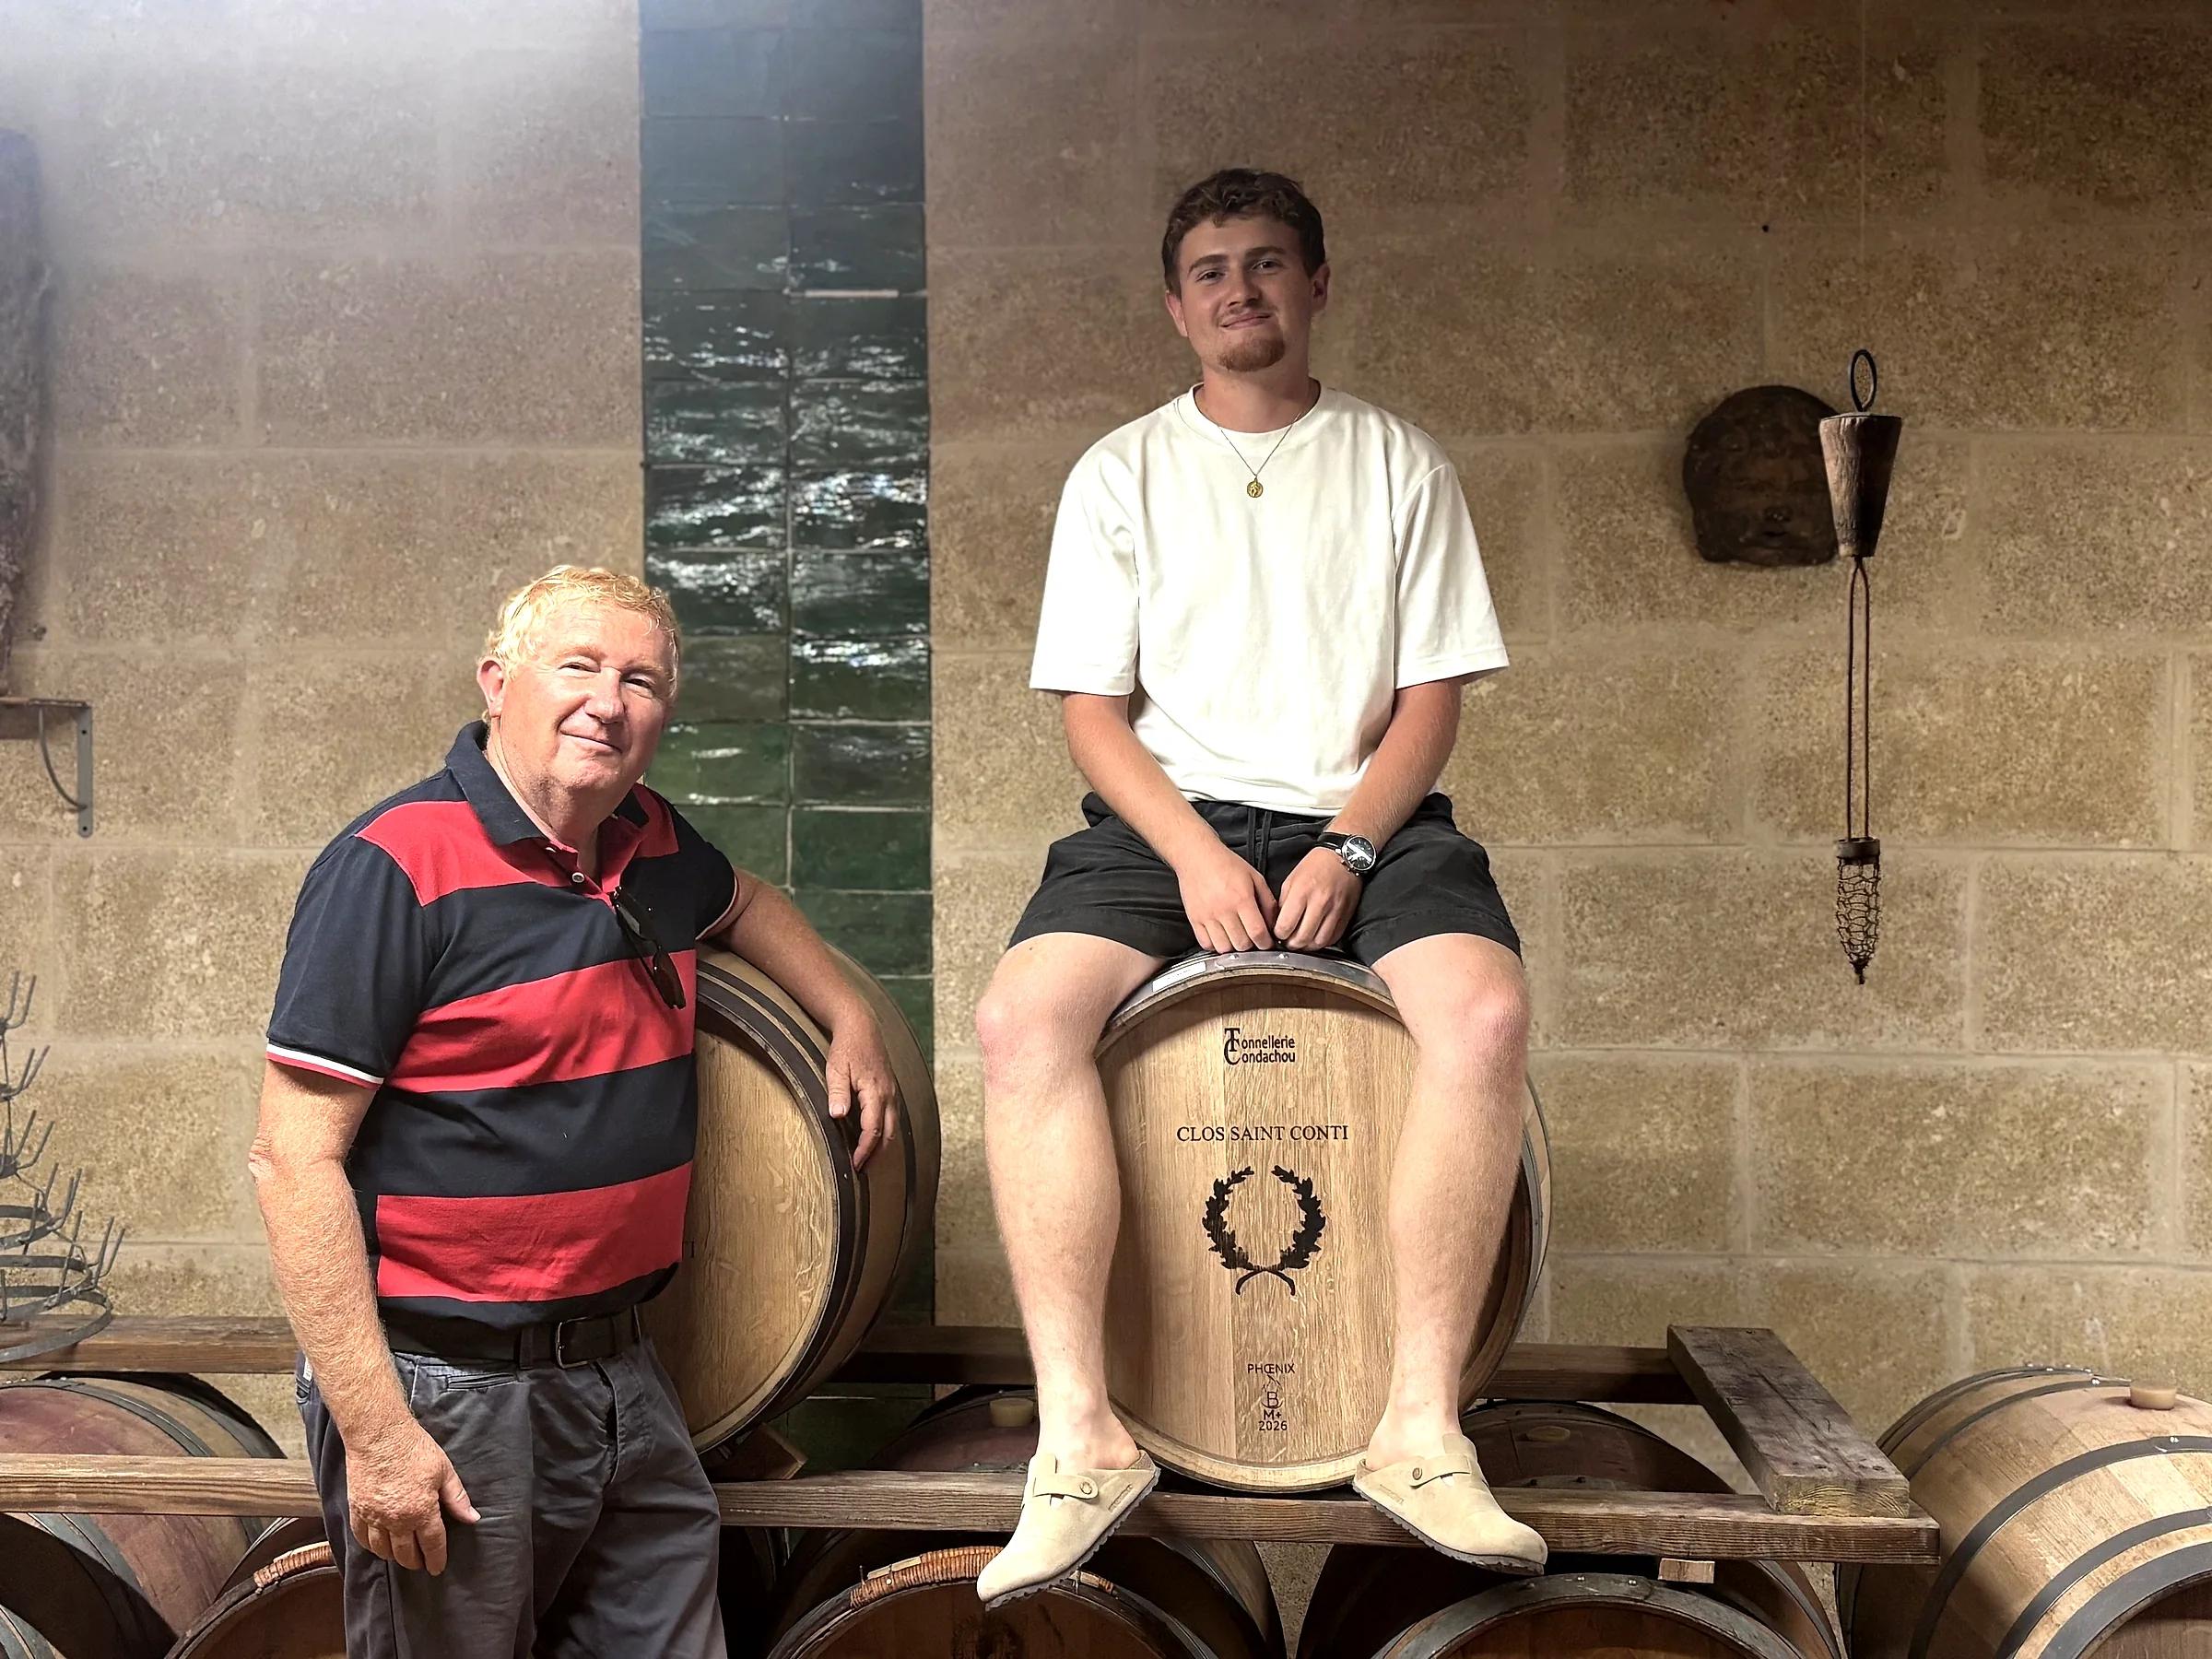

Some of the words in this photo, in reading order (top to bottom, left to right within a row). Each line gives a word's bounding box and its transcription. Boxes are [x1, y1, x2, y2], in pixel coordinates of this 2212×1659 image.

[1224, 1028, 1295, 1052] Tonnellerie
[1224, 1038, 1295, 1065] Condachou
[1176, 1126, 1225, 1141] CLOS
[1230, 1125, 1286, 1141] SAINT
[1290, 1125, 1348, 1140] CONTI
[1247, 1363, 1295, 1373] PHŒNIX
[1264, 1409, 1282, 1420] M+
[1258, 1420, 1288, 1430] 2026
